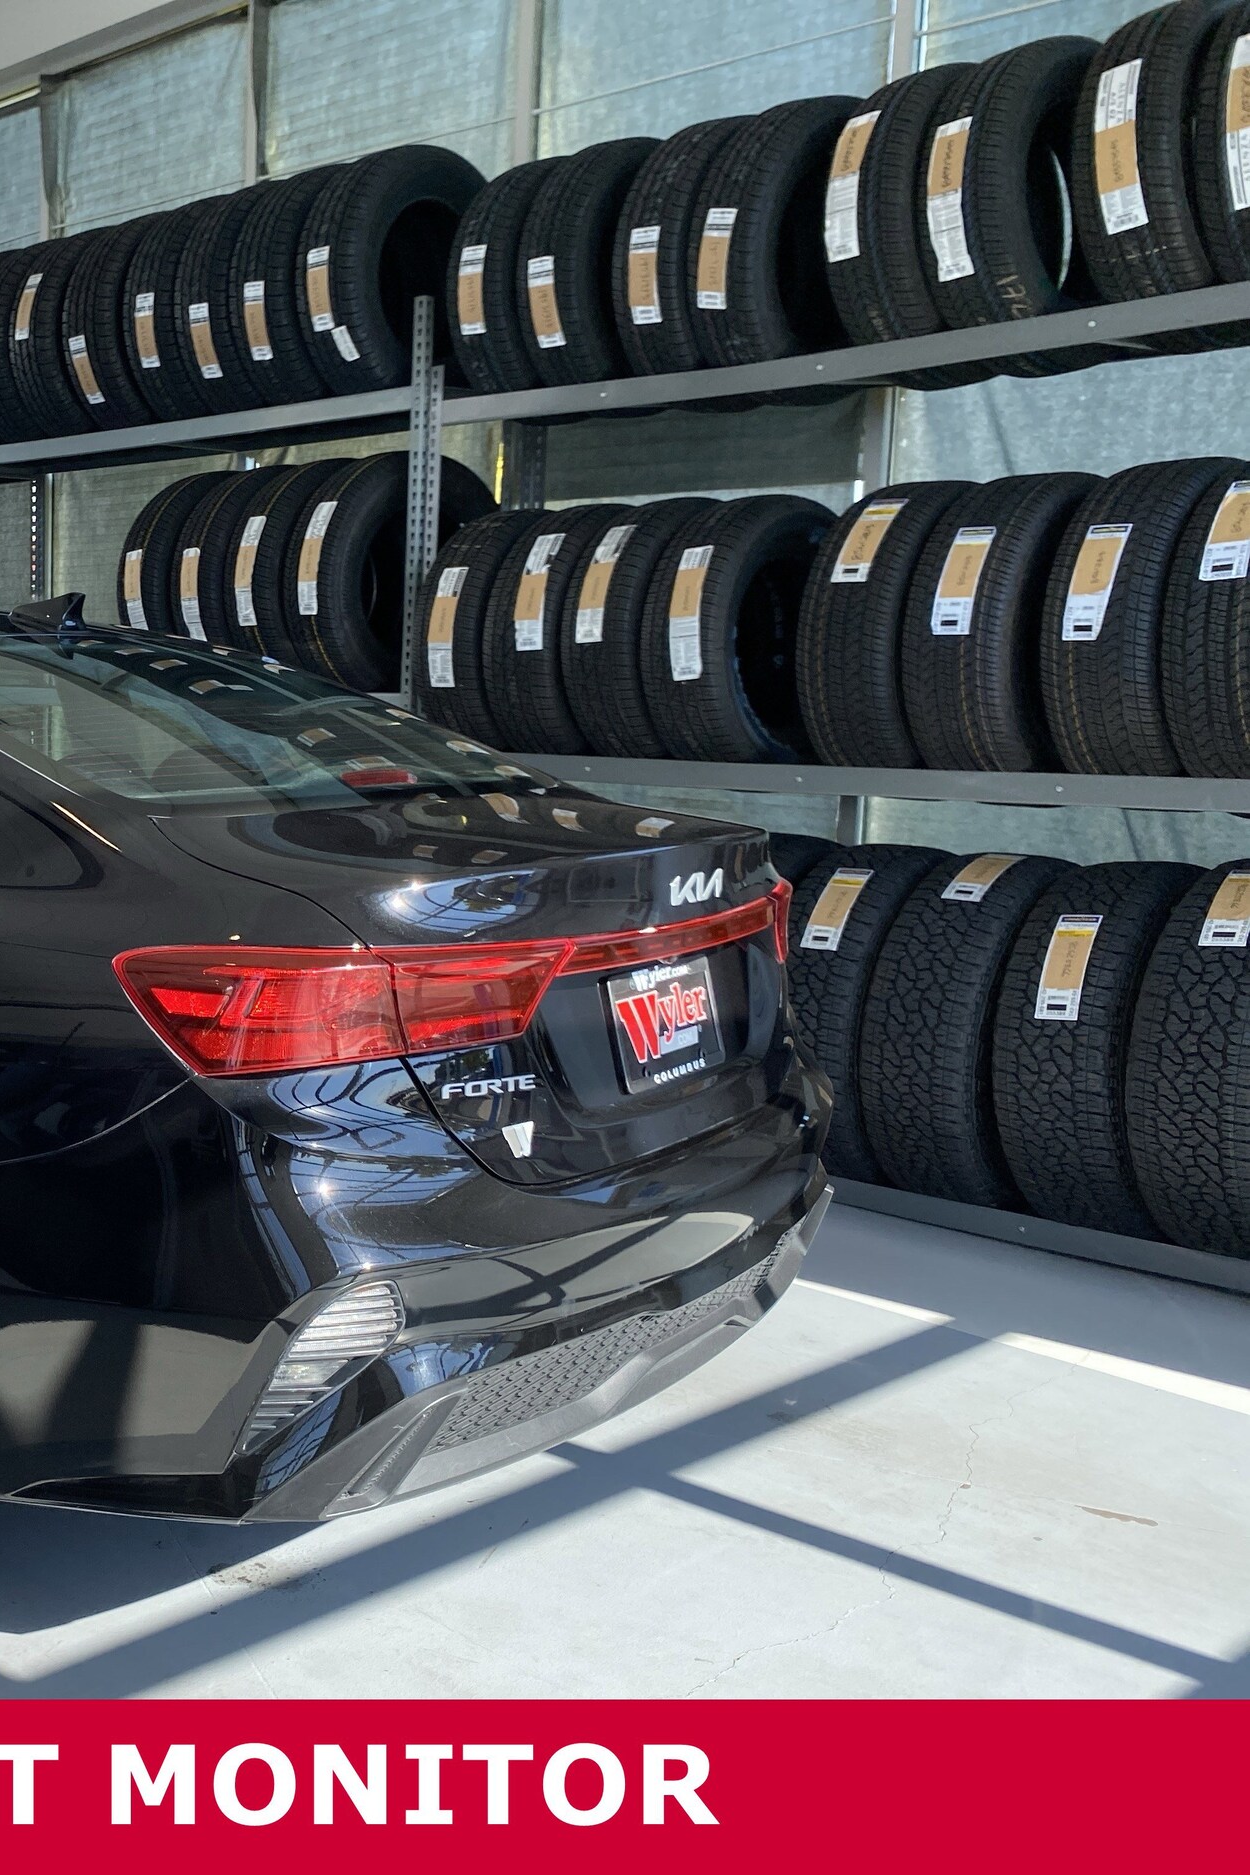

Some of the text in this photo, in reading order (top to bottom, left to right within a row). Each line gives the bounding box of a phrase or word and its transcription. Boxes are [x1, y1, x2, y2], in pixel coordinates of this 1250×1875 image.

[669, 867, 723, 906] KIA
[614, 981, 707, 1064] Wyler
[441, 1073, 536, 1099] FORTE
[653, 1058, 706, 1084] COLUMBUS
